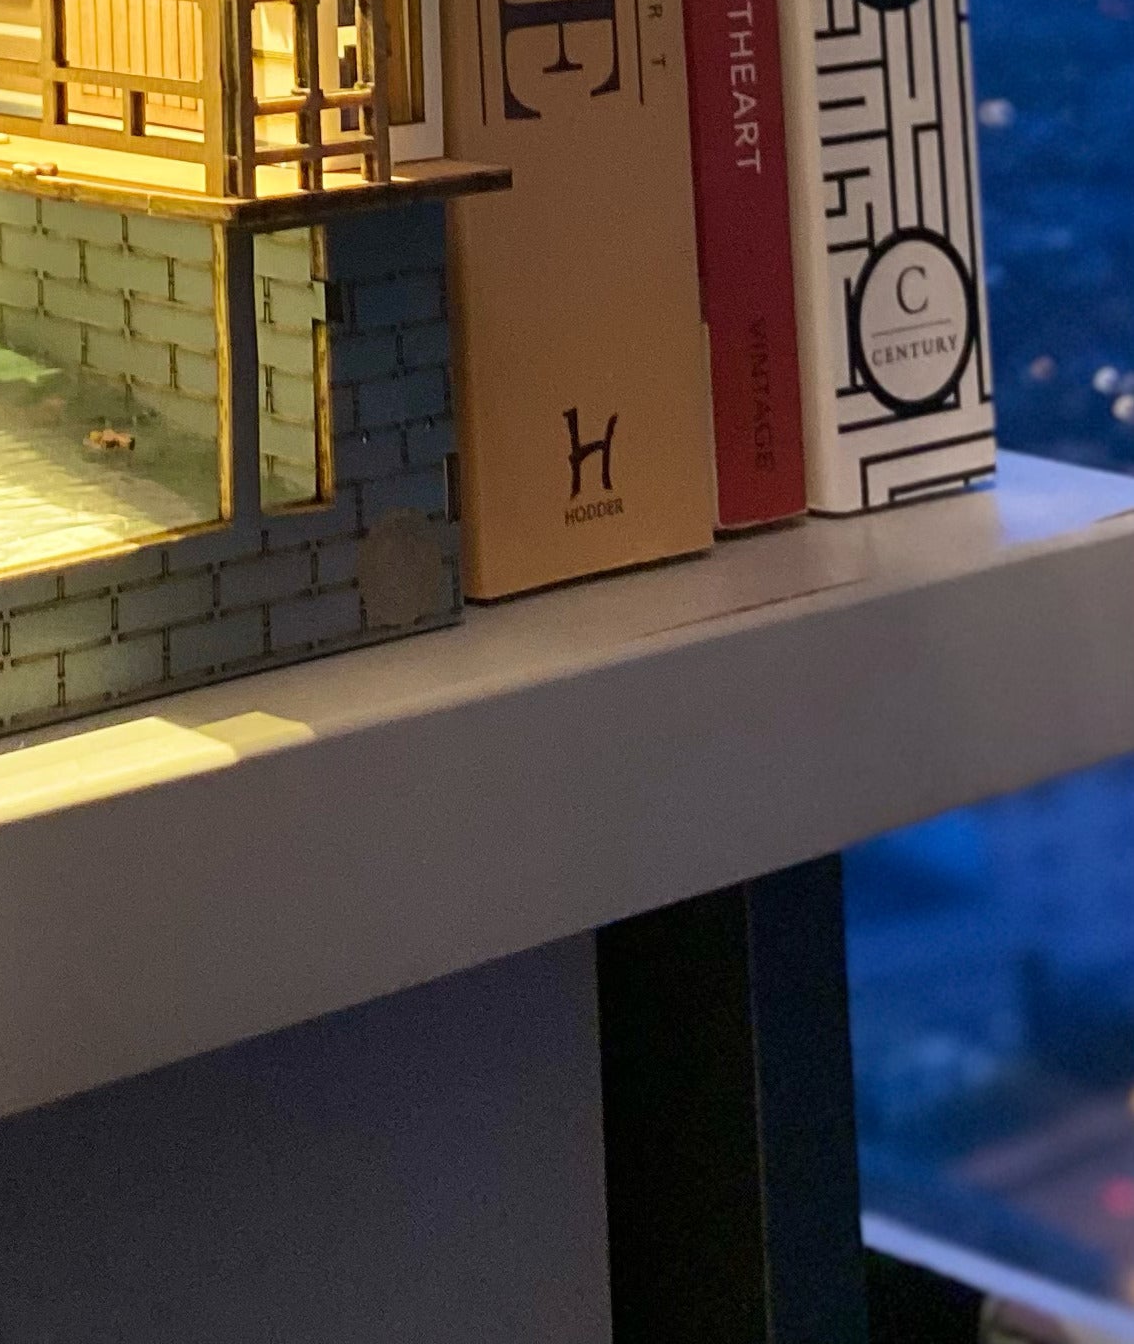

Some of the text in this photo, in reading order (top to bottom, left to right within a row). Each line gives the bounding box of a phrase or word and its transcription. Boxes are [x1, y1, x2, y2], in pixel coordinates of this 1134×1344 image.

[895, 265, 930, 315] C
[871, 333, 959, 368] CENTURY
[564, 497, 624, 528] HODDER
